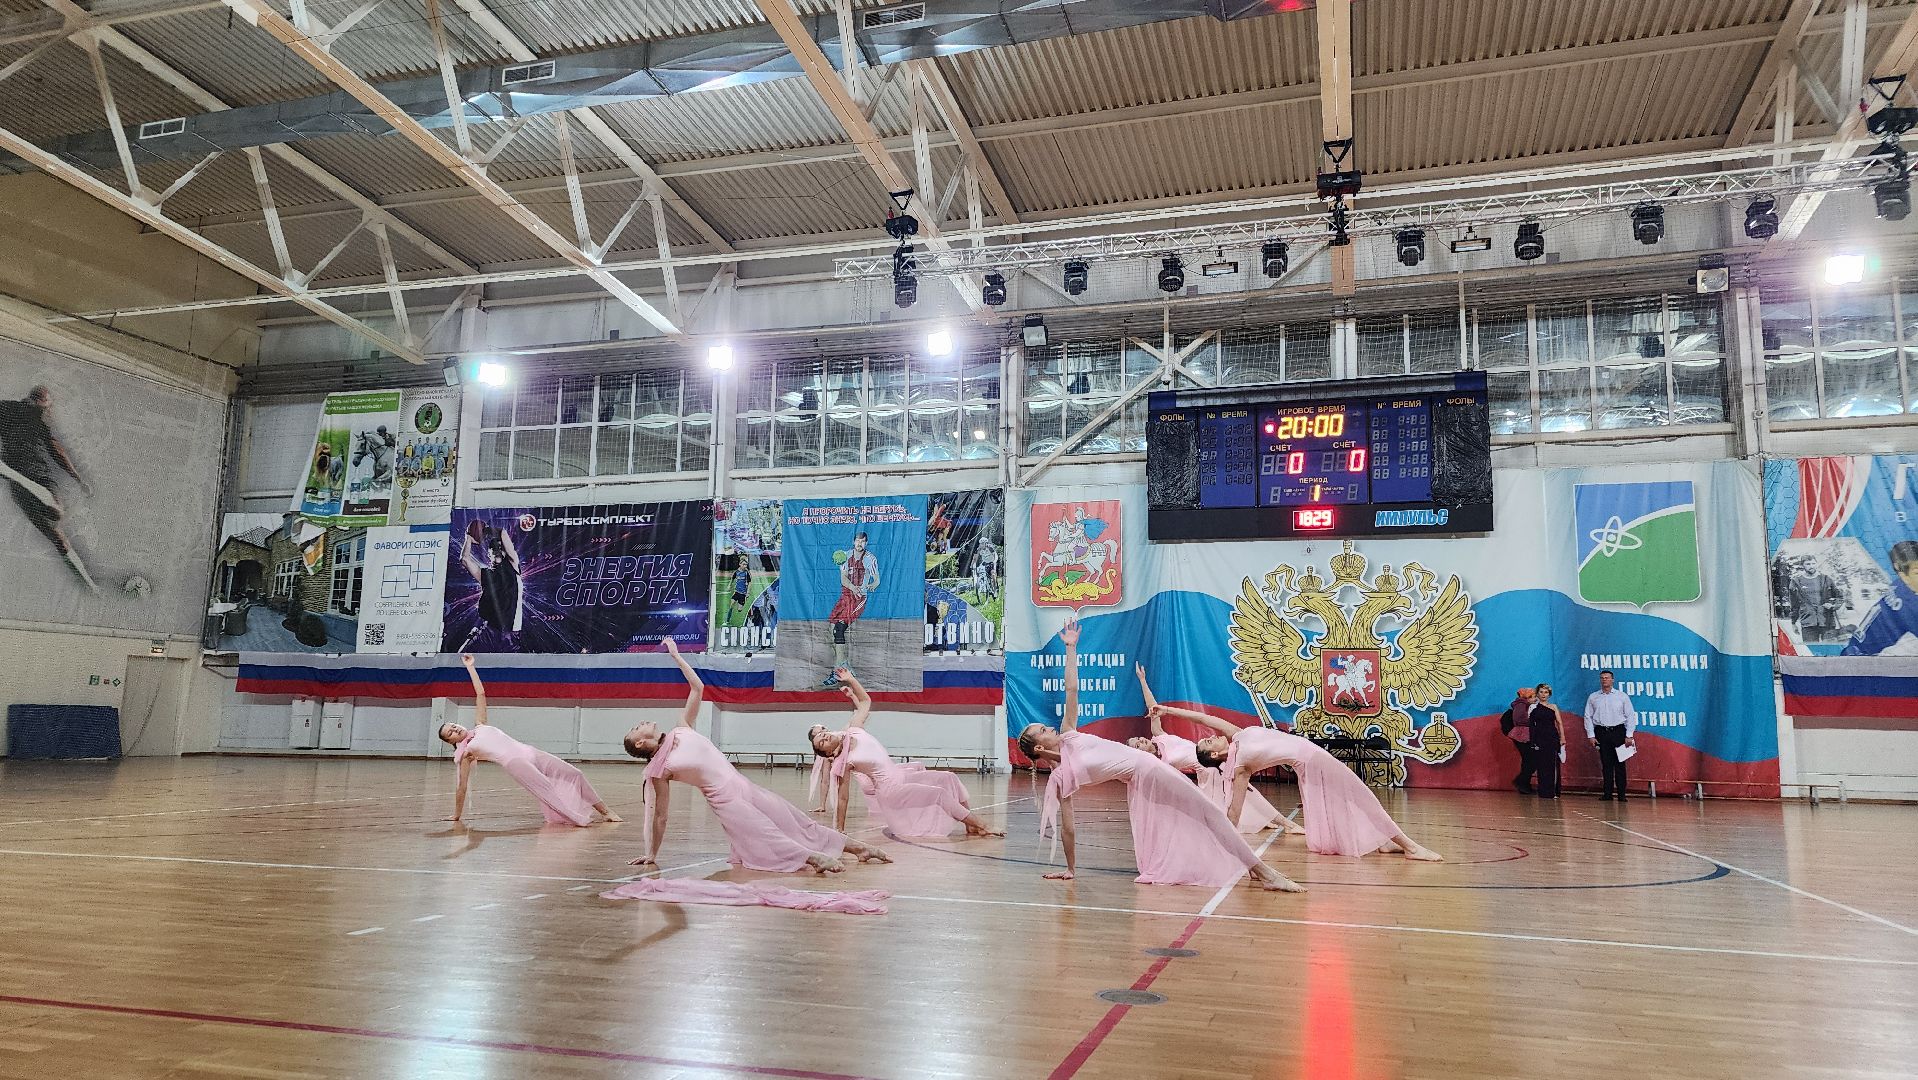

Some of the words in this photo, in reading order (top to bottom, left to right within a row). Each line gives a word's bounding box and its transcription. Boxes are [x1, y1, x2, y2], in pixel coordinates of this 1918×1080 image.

[1392, 399, 1422, 409] ВРЕМЯ
[1447, 397, 1475, 405] ФОЛЫ
[1160, 413, 1185, 421] ФОЛЫ
[1222, 410, 1248, 419] ВРЕМЯ
[1277, 406, 1314, 416] ИГРОВОЕ
[1317, 404, 1346, 413] ВРЕМЯ
[1277, 413, 1344, 440] 20:00
[1287, 451, 1304, 475] 0
[1348, 448, 1366, 473] 0
[802, 508, 809, 516] Я
[810, 506, 859, 516] ПРОРОЧИТЬ
[860, 505, 872, 514] НЕ
[1375, 508, 1449, 527] ИМПУЛЬС
[537, 515, 655, 526] ТУРБОКОМПЛЕКТ
[788, 516, 800, 525] НО
[802, 516, 829, 525] ТОЧНО
[830, 515, 857, 525] ЗНАЮ,
[859, 514, 876, 524] ЧТО
[374, 541, 413, 550] ФАВОРИТ
[414, 539, 442, 549] СПЭЙС
[562, 553, 694, 581] ЭНЕРГИЯ
[555, 579, 687, 607] СПОРТА
[925, 621, 995, 645] ОТВИНО
[1580, 653, 1708, 671] АДМИНИСТРАЦИЯ
[1618, 681, 1675, 699] ГОРОДА
